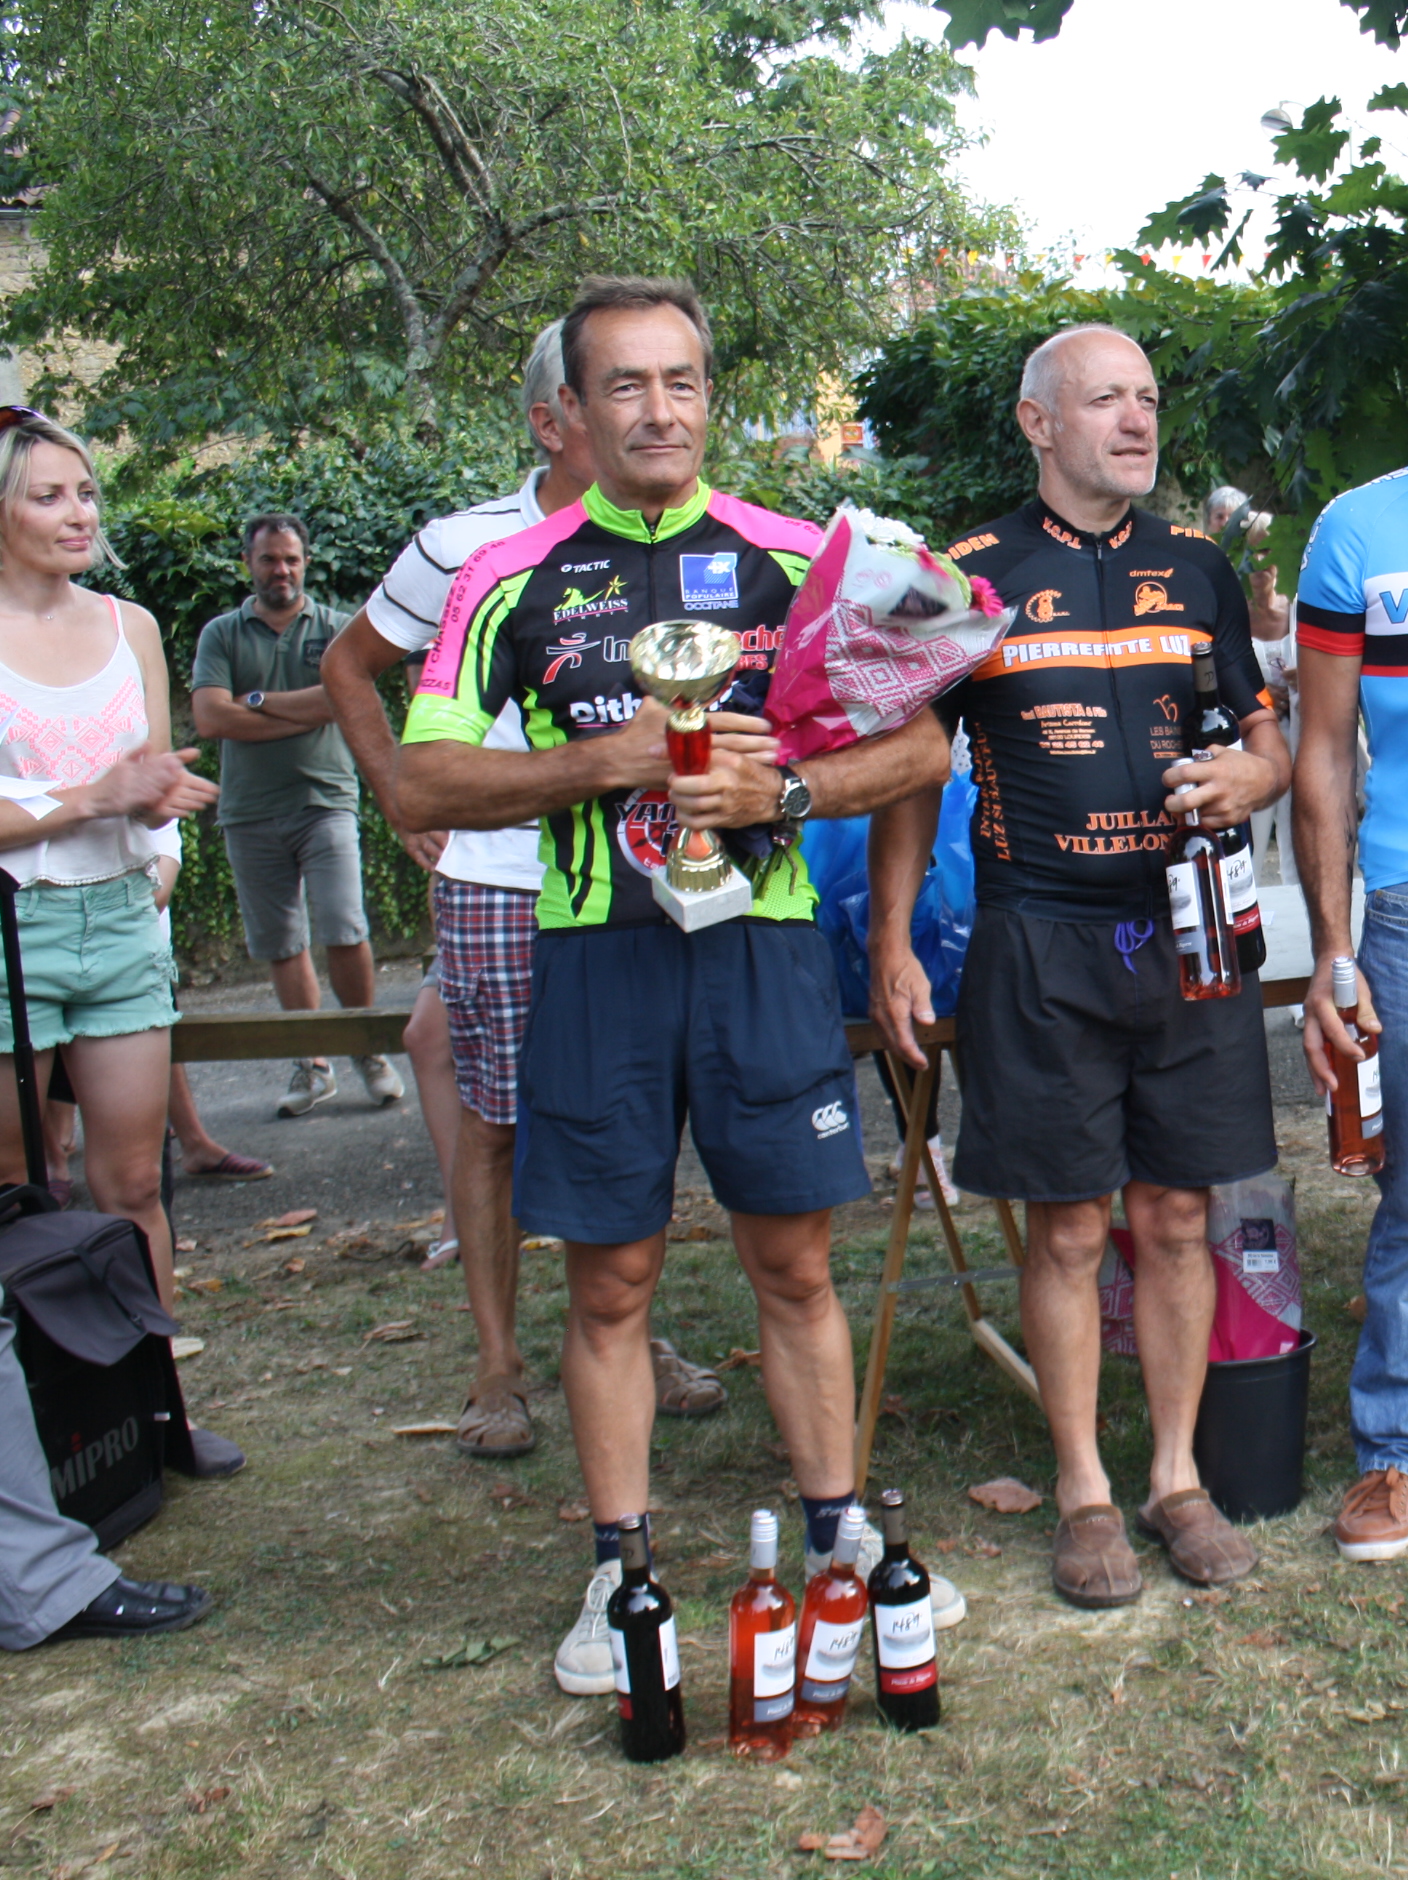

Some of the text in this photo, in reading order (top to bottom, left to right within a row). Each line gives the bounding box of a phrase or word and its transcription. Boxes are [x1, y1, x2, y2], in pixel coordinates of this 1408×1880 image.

[573, 560, 610, 573] TACTIC
[553, 598, 628, 620] EDELWEISS
[684, 599, 739, 611] OCCITANE
[1002, 637, 1153, 668] PIERREFITTE
[1034, 703, 1086, 718] BAUTISTA
[1085, 810, 1176, 831] JUILLA
[1053, 833, 1172, 855] VILLELON
[51, 1415, 140, 1501] MIPRO
